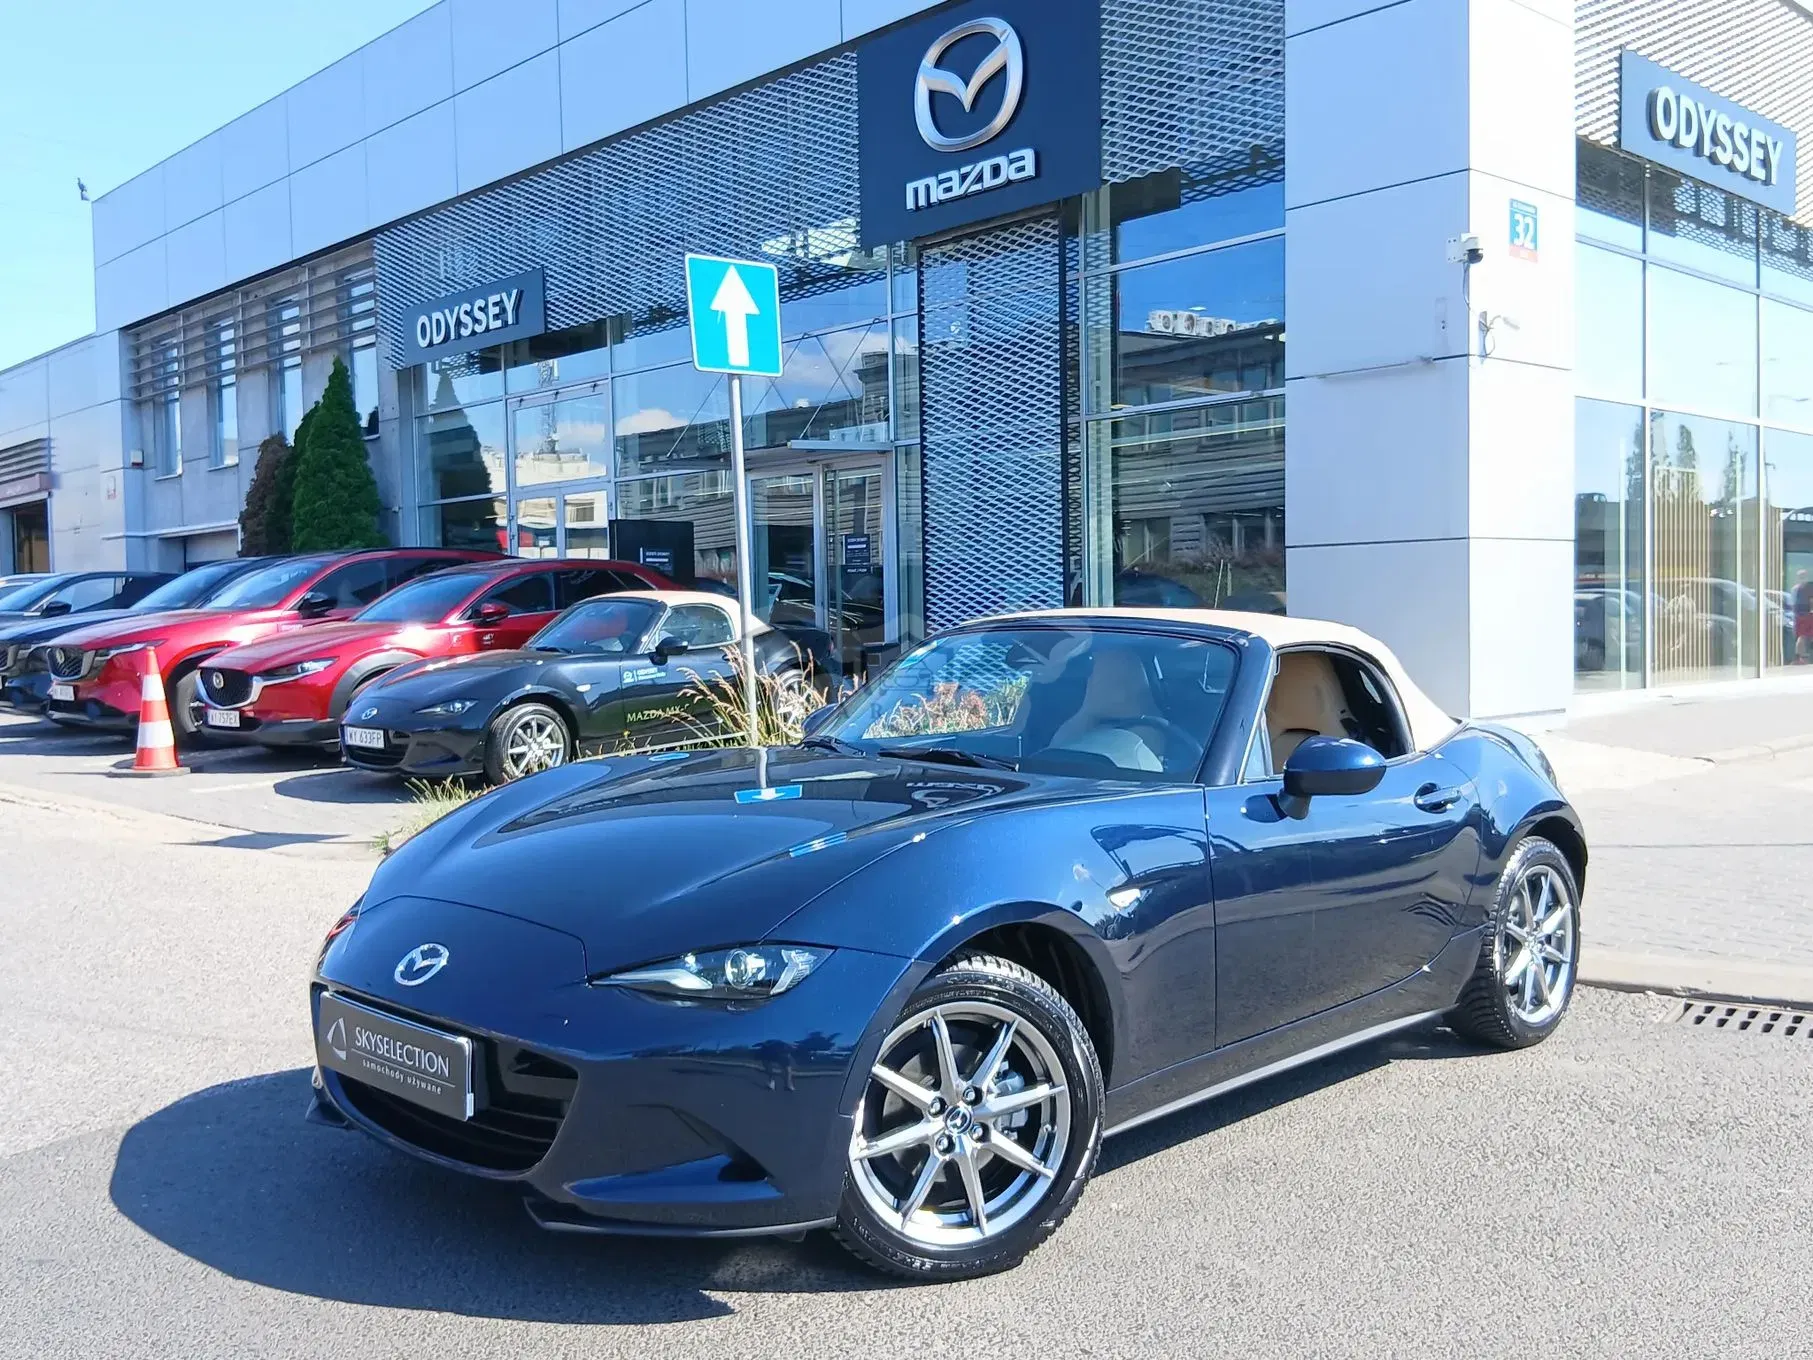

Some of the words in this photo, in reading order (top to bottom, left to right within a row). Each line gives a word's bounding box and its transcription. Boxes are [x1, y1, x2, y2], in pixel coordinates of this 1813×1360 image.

[1653, 86, 1784, 185] ODYSSEY
[1513, 213, 1536, 249] 32
[416, 288, 520, 348] ODYSSEY
[626, 708, 664, 723] MAZDA
[355, 1026, 450, 1078] SKYSELECTION
[362, 1058, 404, 1083] samochody
[407, 1076, 442, 1095] używane
